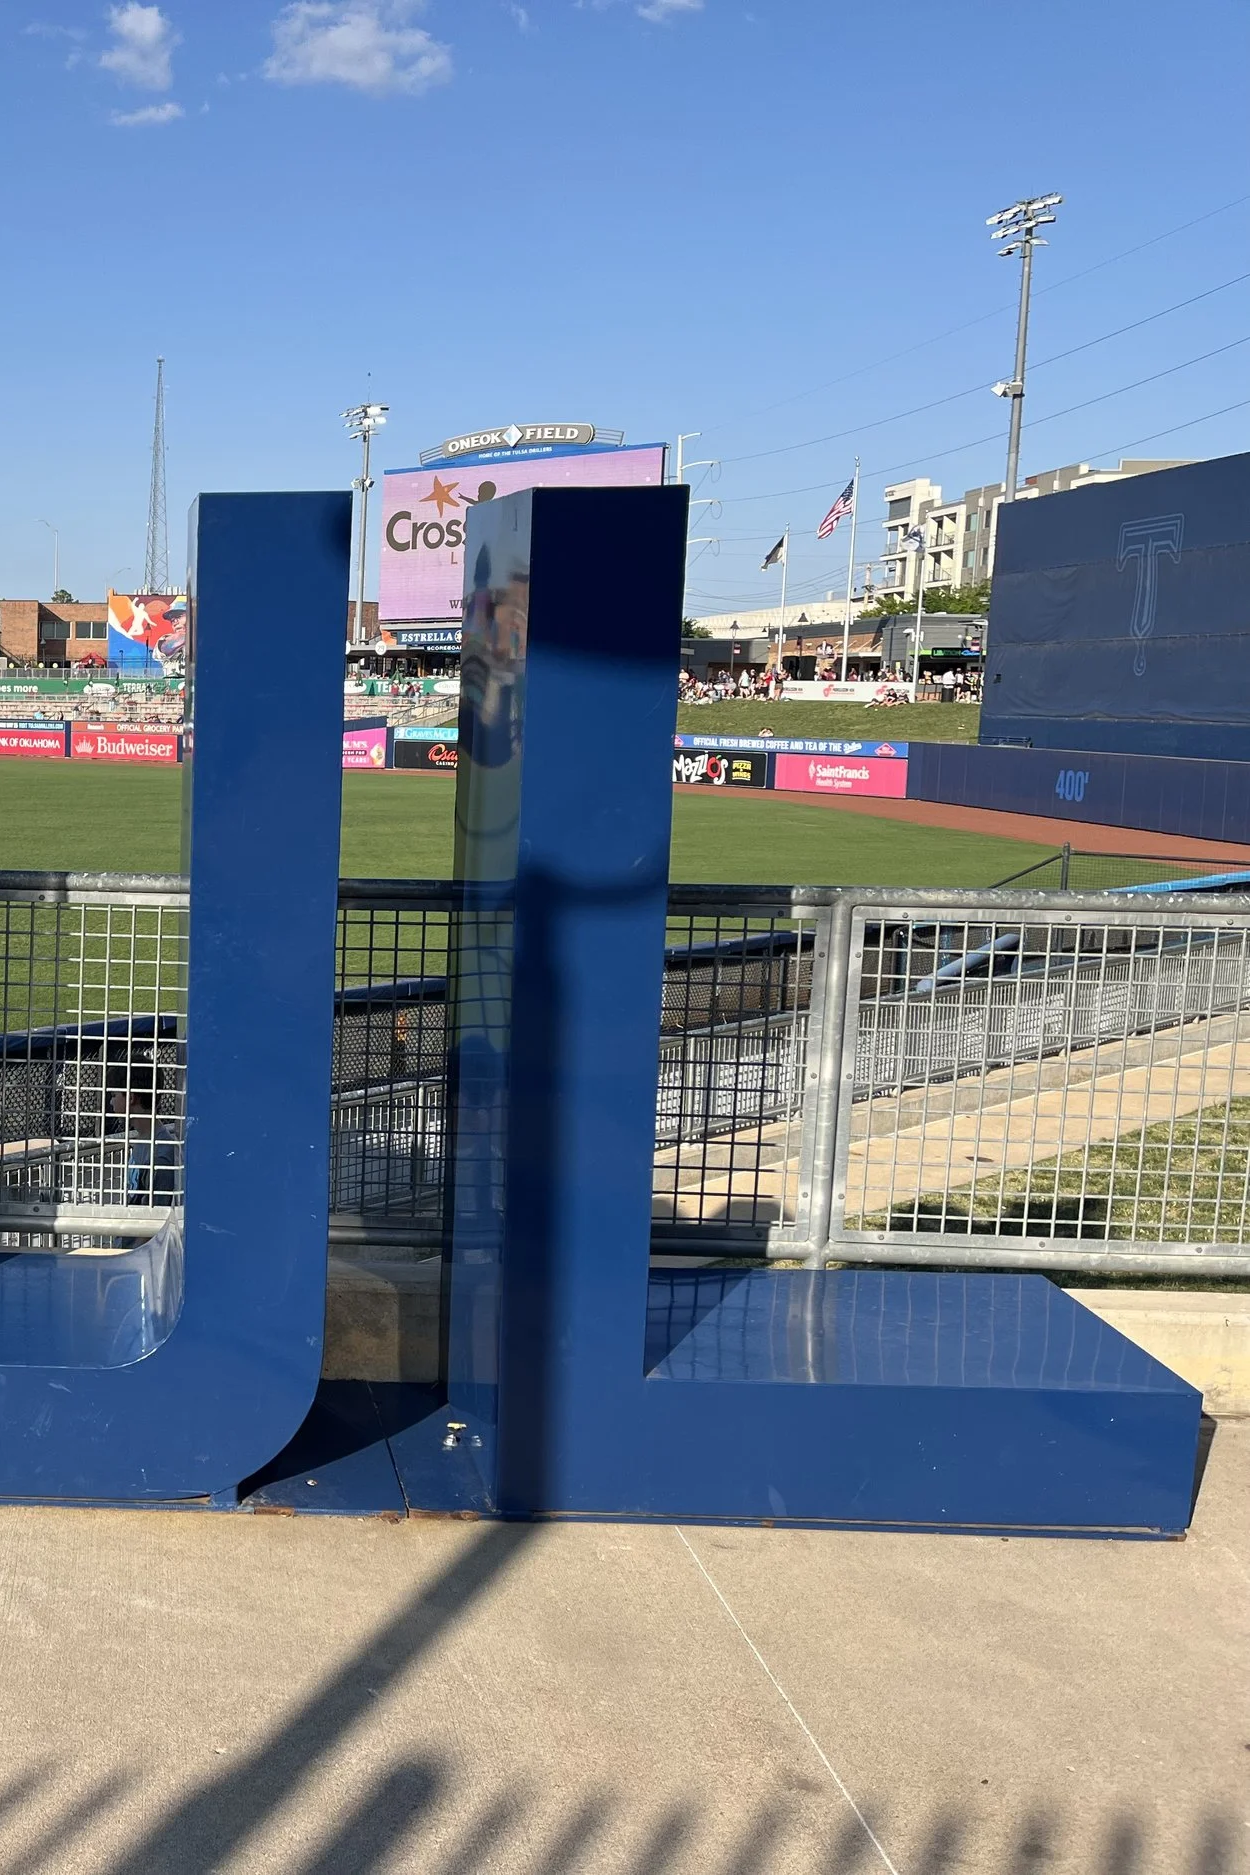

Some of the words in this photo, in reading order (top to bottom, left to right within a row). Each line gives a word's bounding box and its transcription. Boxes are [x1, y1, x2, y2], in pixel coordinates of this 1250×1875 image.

[448, 431, 503, 453] ONEOK
[525, 427, 579, 440] FIELD
[512, 448, 528, 456] TULSA
[401, 632, 453, 643] ESTRELLA
[13, 685, 39, 693] more
[116, 724, 142, 732] OFFICIAL
[143, 724, 171, 733] GROCERY
[10, 738, 18, 747] OF
[19, 738, 60, 749] OKLAHOMA
[96, 736, 173, 757] Budweiser
[693, 736, 719, 747] OFFICIAL
[719, 737, 738, 748] FRESH
[739, 738, 765, 749] BREWED
[765, 739, 790, 750] COFFEE
[790, 740, 804, 751] AND
[805, 741, 818, 751] TEA
[818, 742, 828, 752] OF
[829, 742, 842, 752] THE
[732, 762, 752, 770] PIZZA
[815, 777, 833, 787] Health
[833, 778, 853, 789] System
